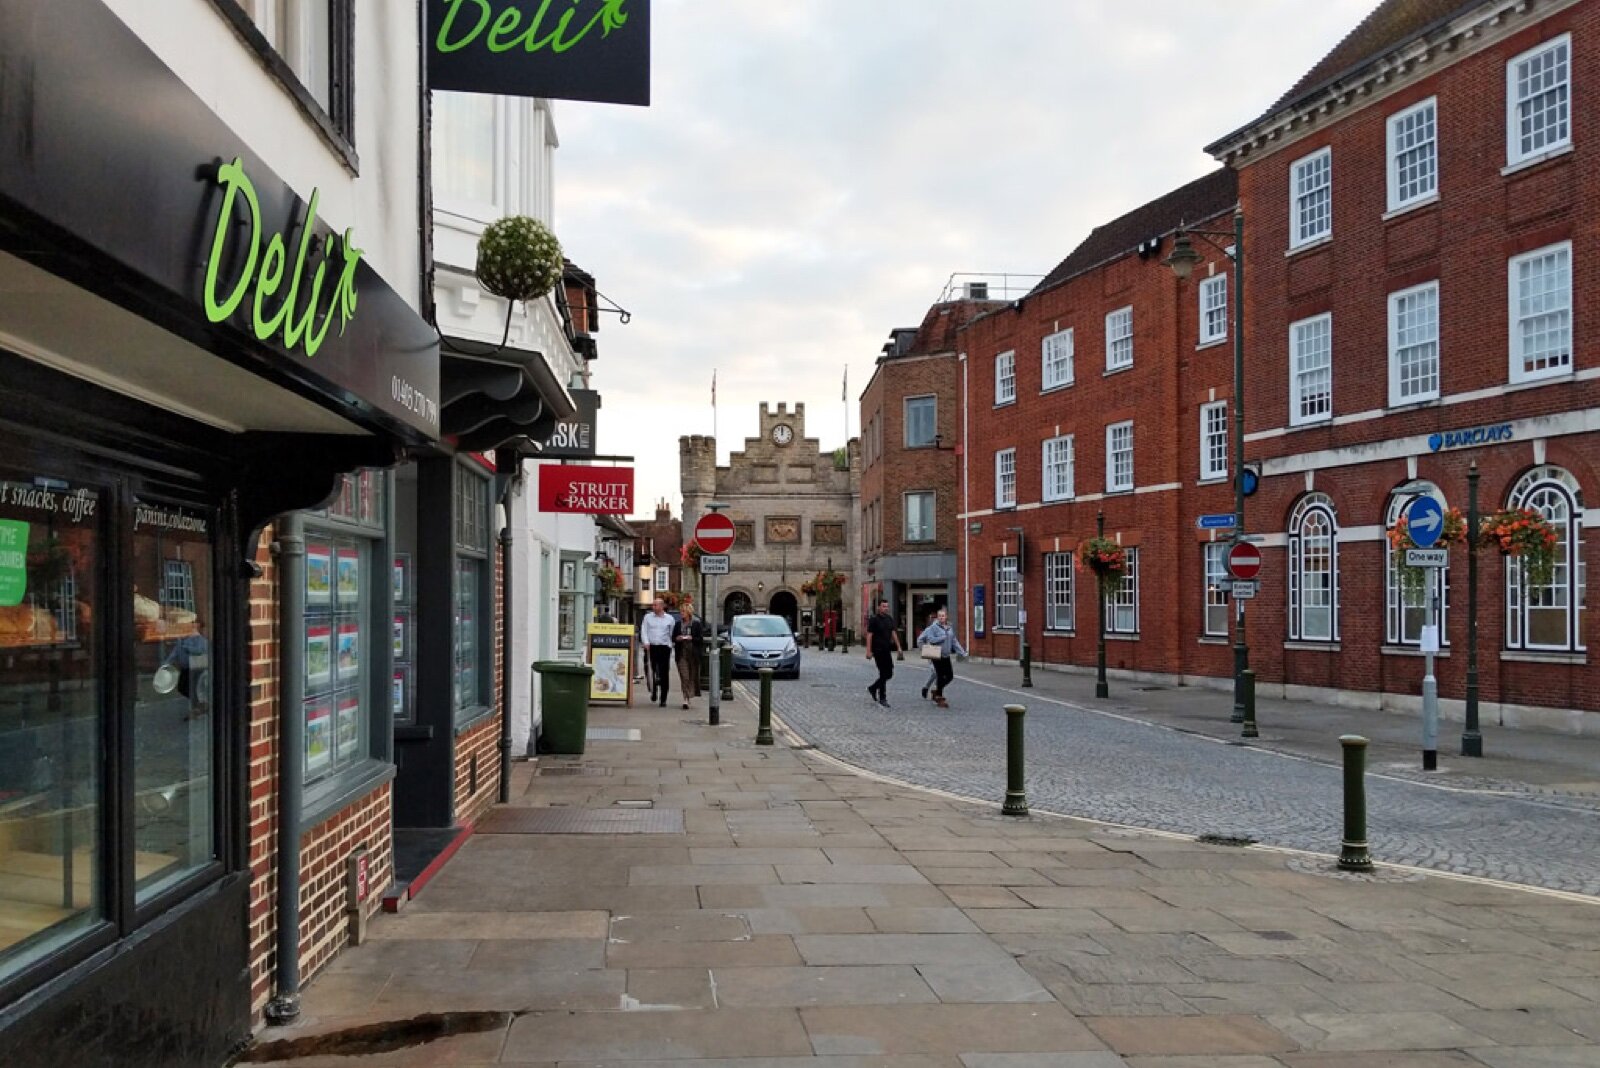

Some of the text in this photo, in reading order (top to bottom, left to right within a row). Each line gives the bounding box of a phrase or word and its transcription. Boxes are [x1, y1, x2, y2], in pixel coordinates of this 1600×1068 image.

[436, 0, 604, 52] Deli
[205, 157, 355, 357] Deli
[1444, 424, 1512, 447] BARCLAYS
[568, 481, 629, 496] STRUTT
[11, 481, 59, 513] snacks,
[62, 488, 97, 523] coffee
[568, 496, 629, 510] PARKER
[702, 557, 727, 565] Except
[1408, 552, 1444, 563] One way
